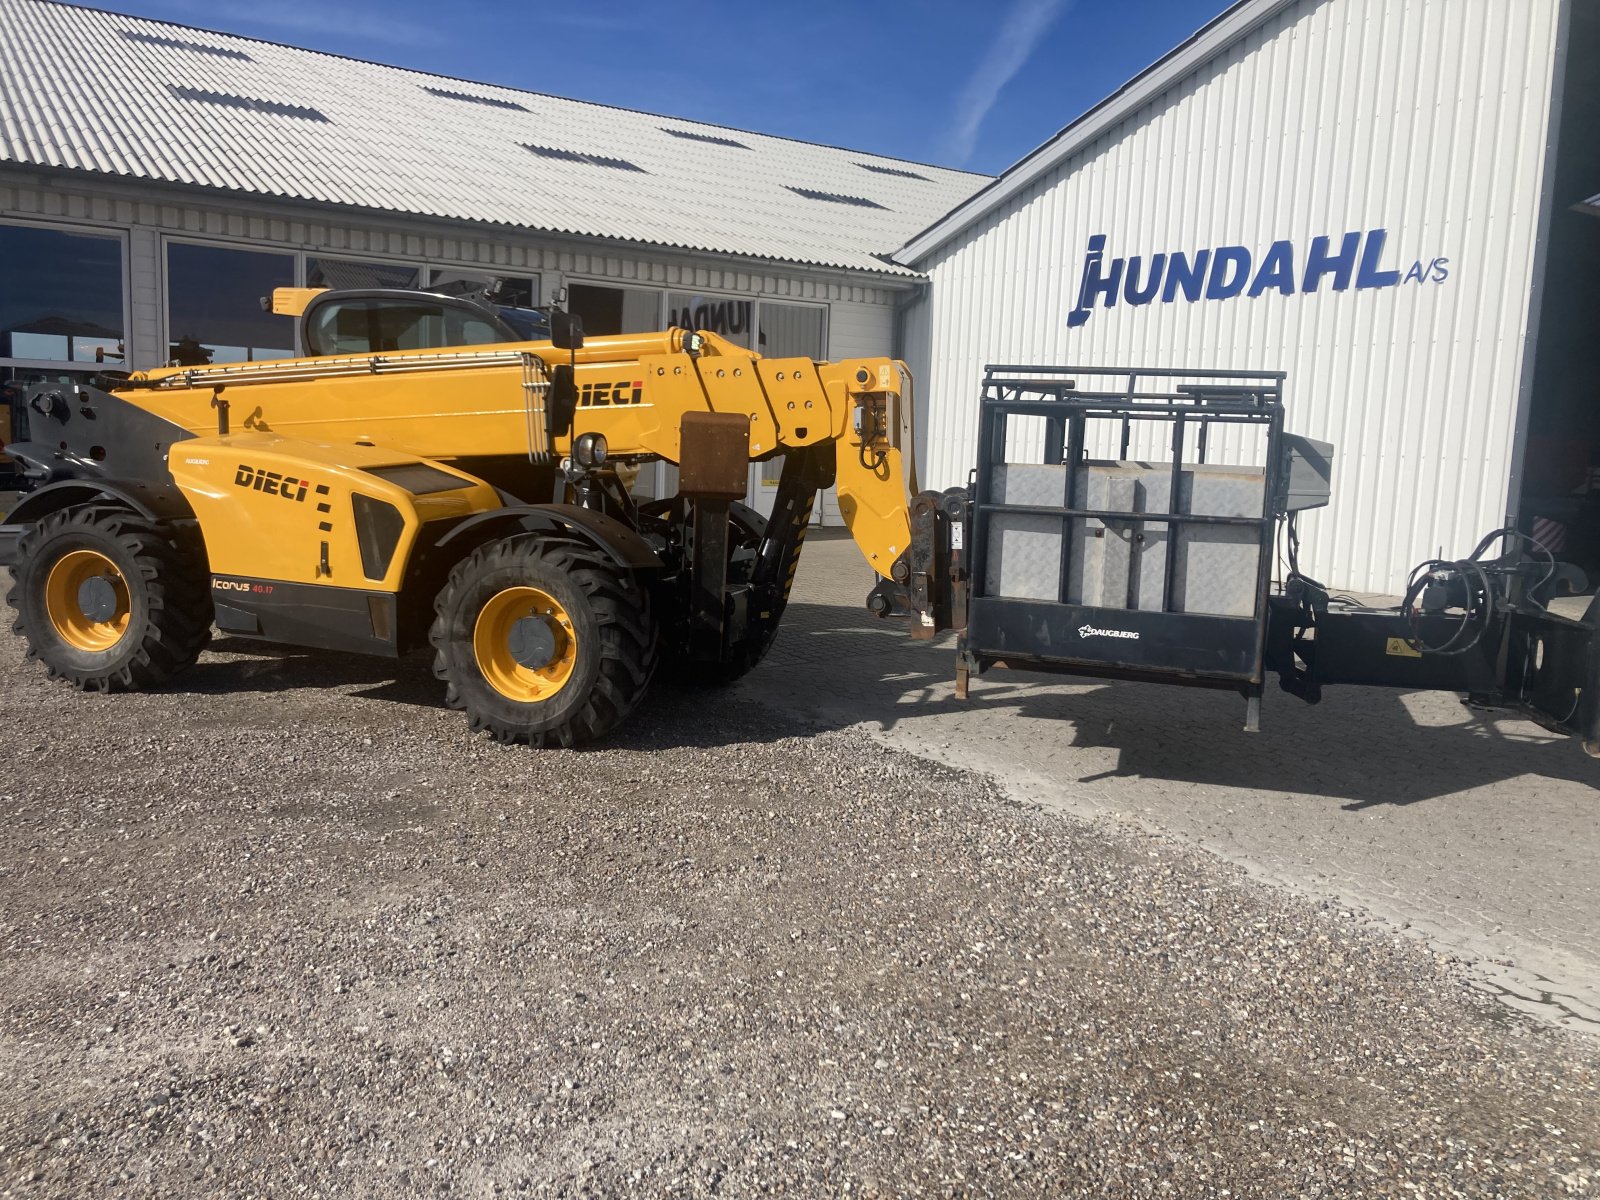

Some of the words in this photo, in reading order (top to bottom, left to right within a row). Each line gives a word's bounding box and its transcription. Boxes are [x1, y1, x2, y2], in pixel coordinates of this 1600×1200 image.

[1404, 257, 1449, 284] A/S
[574, 381, 643, 407] IECI
[234, 464, 309, 502] DIECI
[252, 584, 273, 594] 40.17
[1091, 627, 1140, 640] DAUGBJERG
